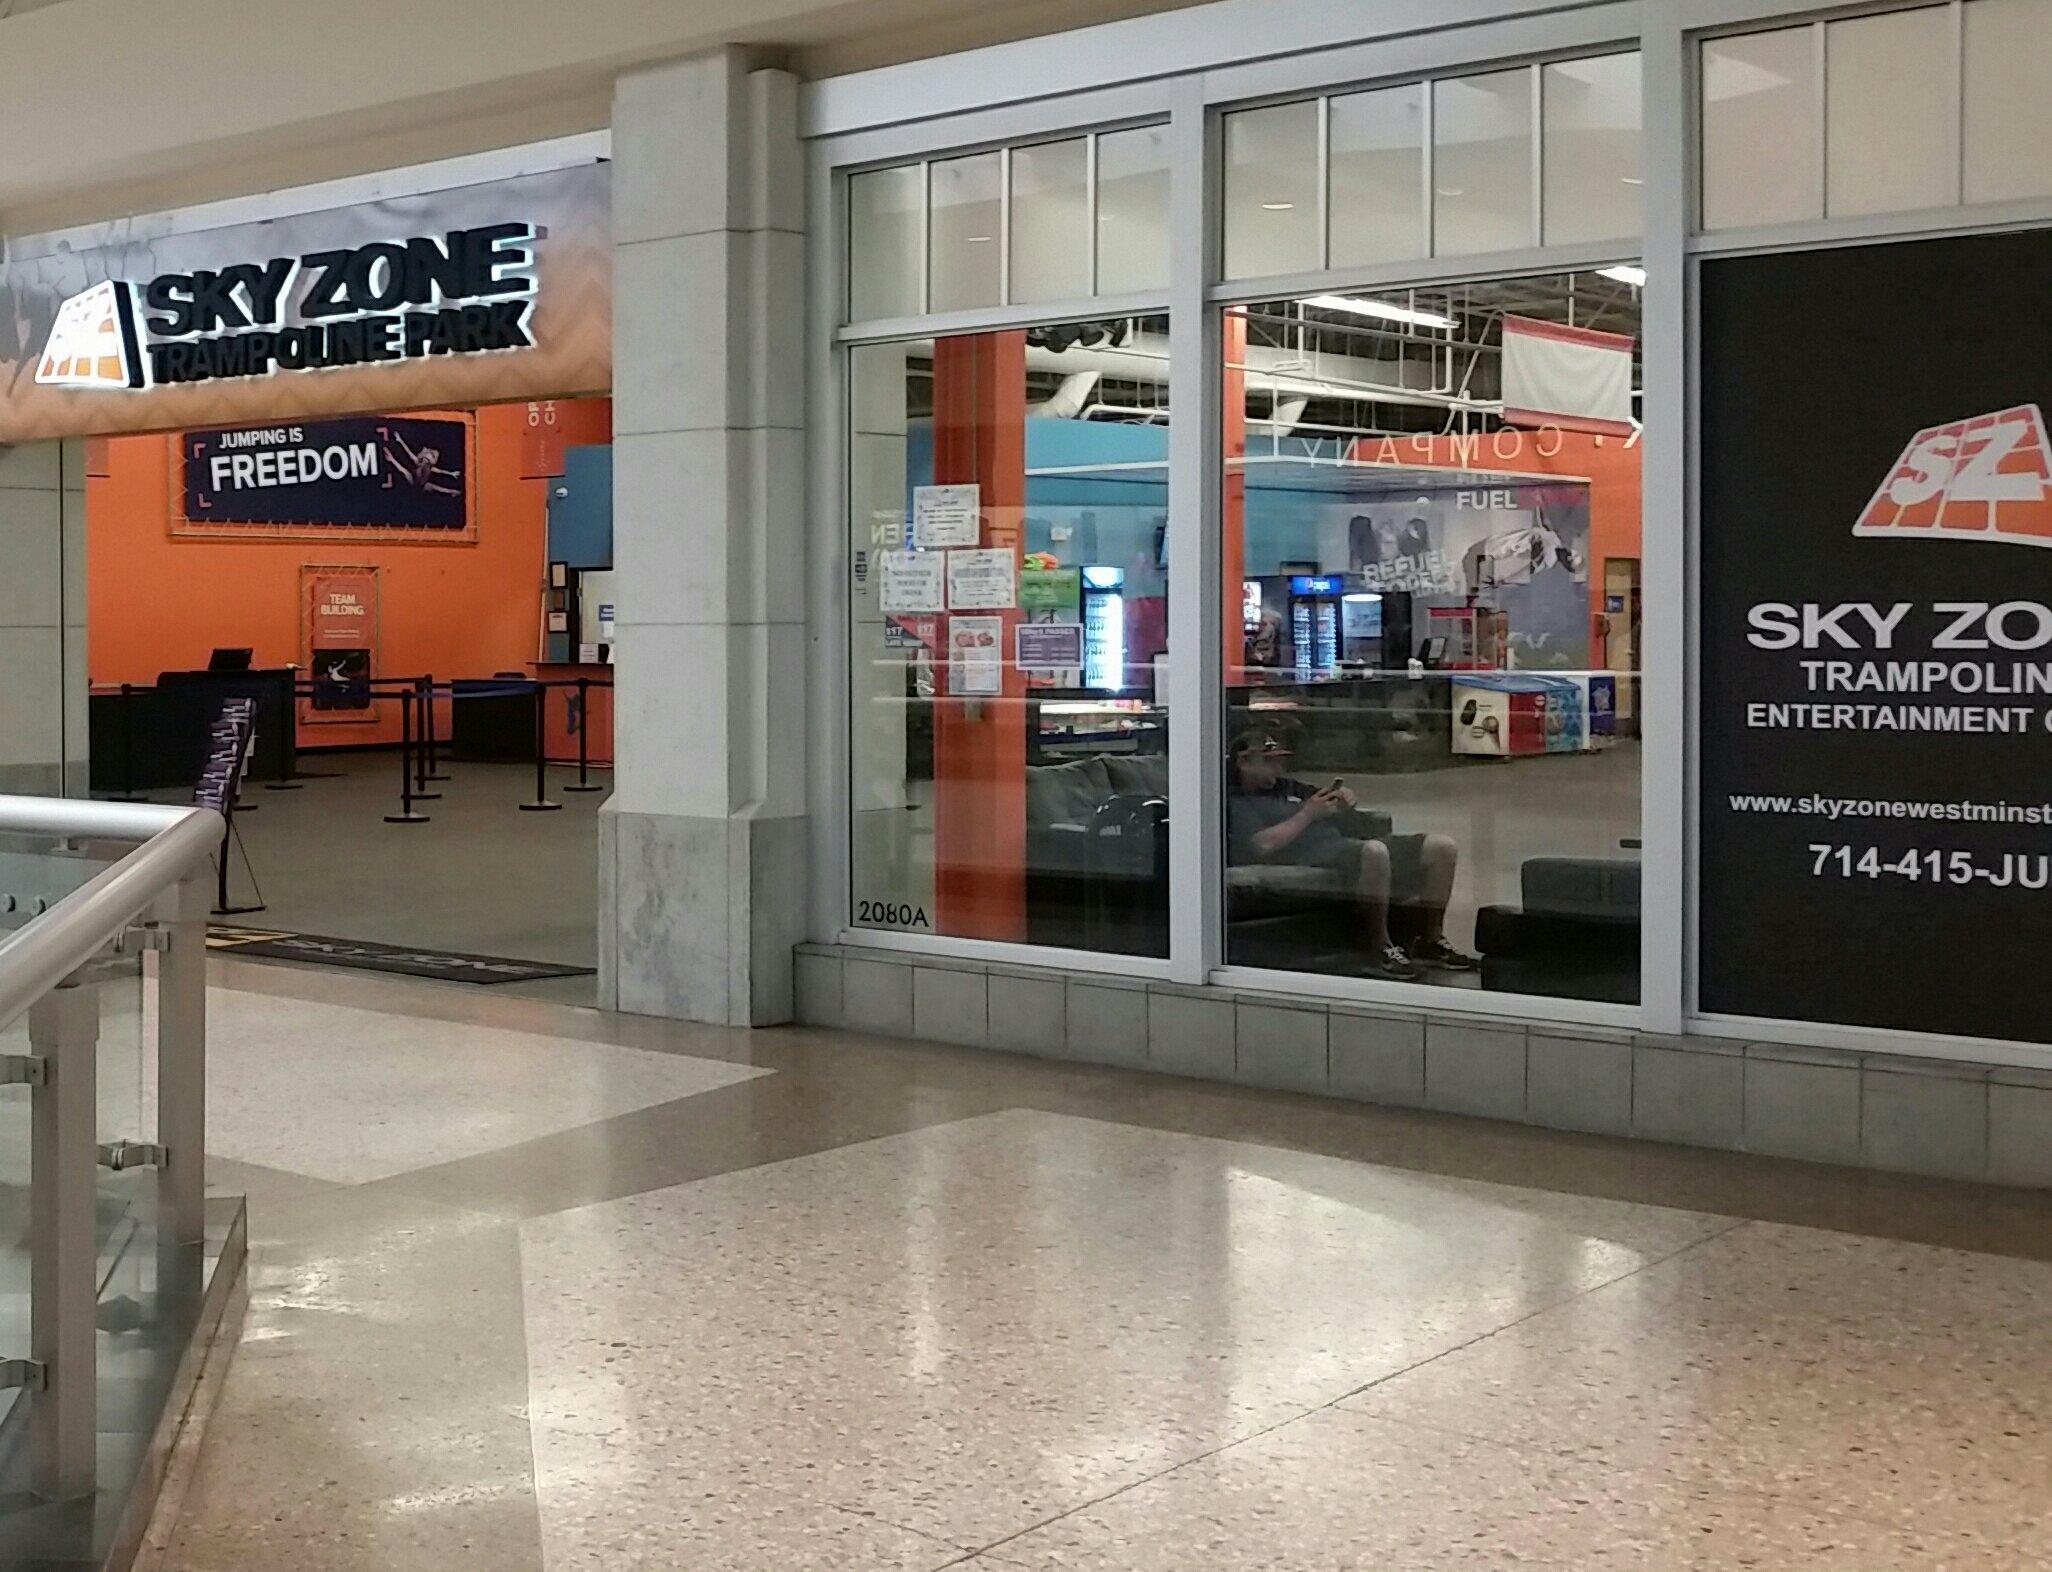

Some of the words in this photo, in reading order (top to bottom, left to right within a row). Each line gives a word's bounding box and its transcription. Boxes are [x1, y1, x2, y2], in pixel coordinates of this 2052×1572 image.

[146, 256, 297, 336] SKY
[300, 222, 532, 319] ZONE
[146, 315, 405, 385] TRAMPOLINE
[403, 300, 533, 357] PARK
[218, 430, 287, 450] JUMPING
[288, 428, 304, 444] IS
[209, 442, 379, 493] FREEDOM
[1456, 490, 1518, 510] FUEL
[320, 605, 364, 616] BUILDING
[329, 594, 356, 605] TEAM
[1747, 601, 1913, 650] SKY
[1932, 601, 2052, 650] ZO
[1800, 661, 2052, 694] TRAMPOLIN
[1747, 704, 2034, 733] ENTERTAINMENT
[1729, 794, 2052, 825] www.skyzonewestminst
[1808, 844, 2049, 889] 714-415-JU
[859, 900, 929, 928] 2080A
